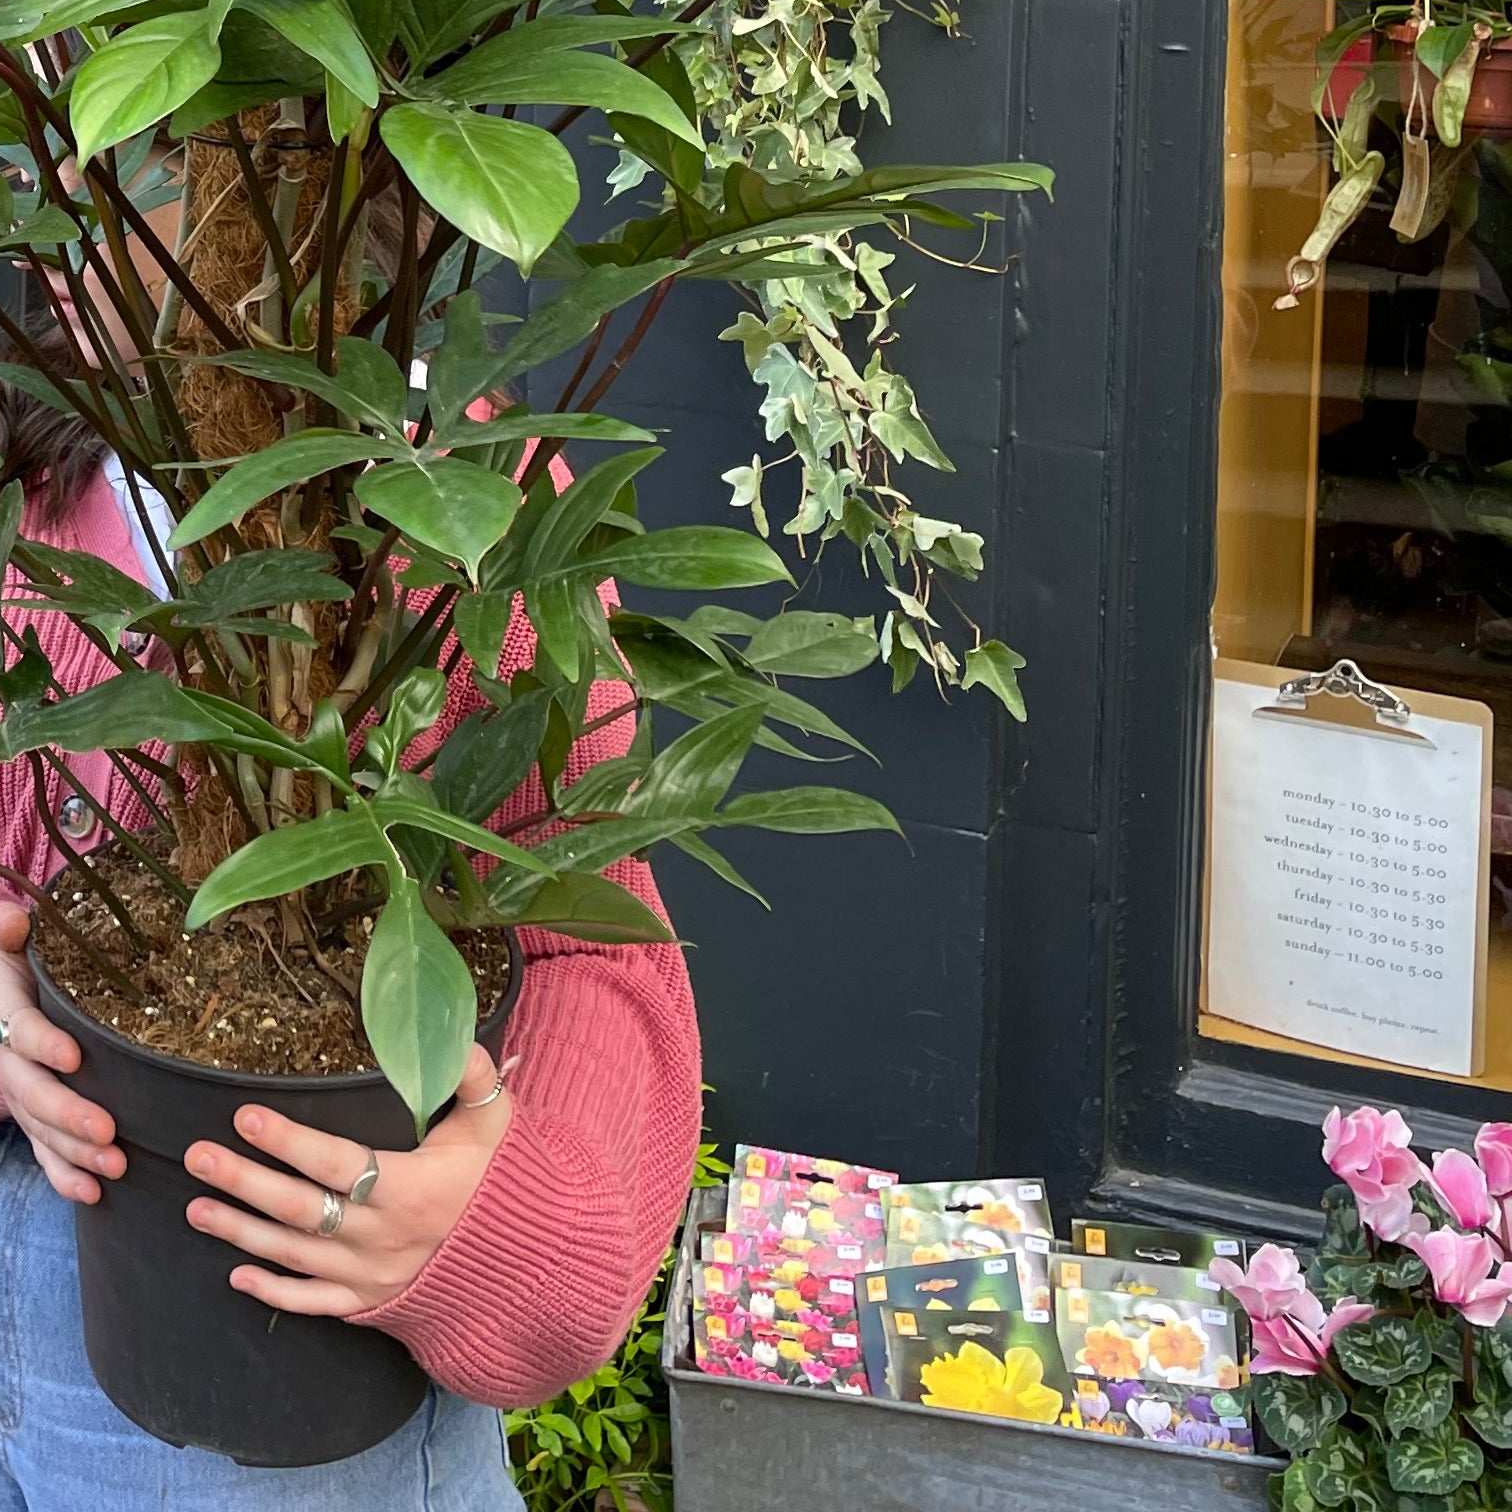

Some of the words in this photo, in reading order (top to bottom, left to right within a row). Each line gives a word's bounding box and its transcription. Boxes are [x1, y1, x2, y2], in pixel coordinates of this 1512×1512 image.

[1283, 789, 1335, 810] monday
[1396, 811, 1409, 821] to
[1286, 814, 1334, 834] tuesday
[1395, 836, 1408, 846] to
[1264, 835, 1333, 859] wednesday
[1394, 861, 1407, 871] to
[1277, 860, 1333, 884] thursday
[1394, 887, 1408, 897] to
[1294, 888, 1332, 909] friday
[1394, 912, 1406, 921] to
[1277, 912, 1332, 934] saturday
[1393, 937, 1406, 947] to
[1285, 940, 1331, 959] sunday
[1391, 962, 1404, 972] to
